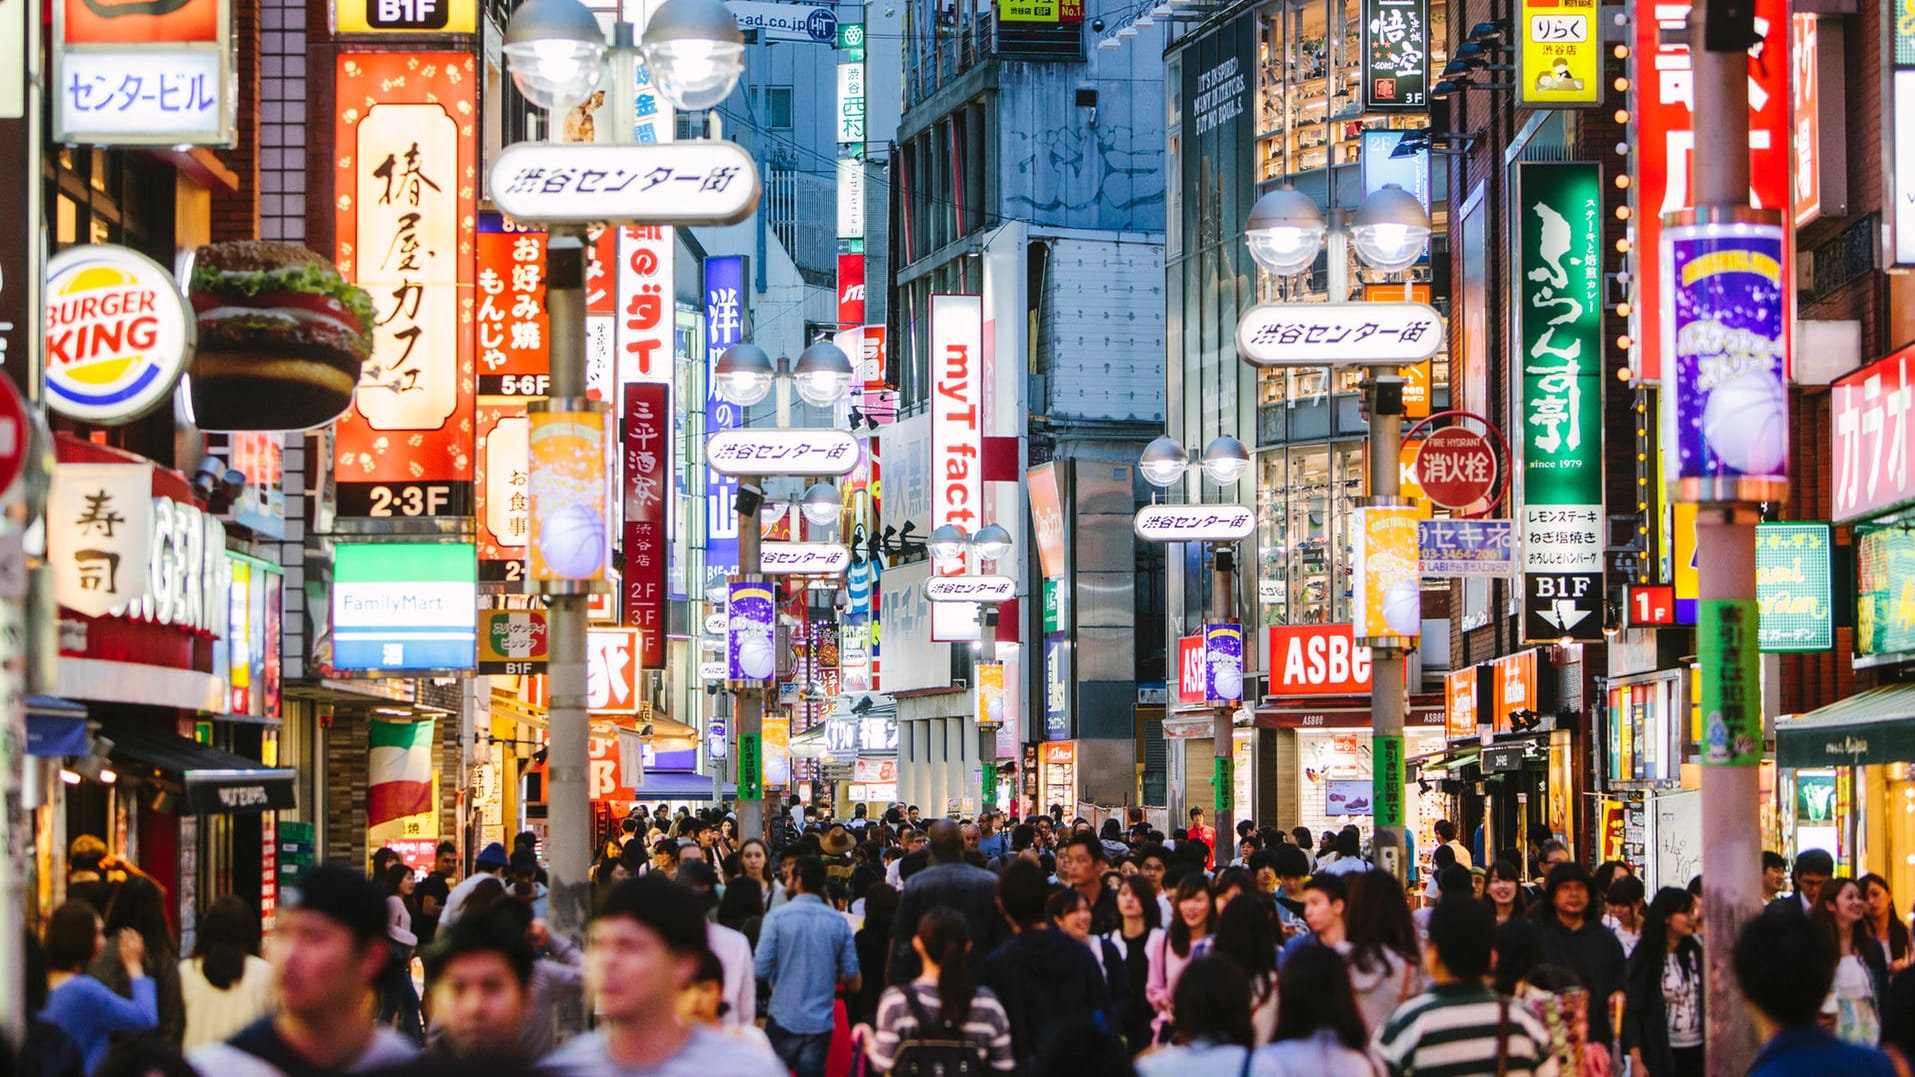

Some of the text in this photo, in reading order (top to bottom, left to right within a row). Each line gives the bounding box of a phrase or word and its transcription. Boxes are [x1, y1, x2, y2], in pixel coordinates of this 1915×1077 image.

[1536, 19, 1580, 39] りらく
[1370, 9, 1423, 77] 悟空
[1542, 45, 1577, 56] 渋谷店
[69, 73, 215, 112] センタービル
[1405, 92, 1423, 103] 3F
[506, 166, 741, 195] 渋谷センター街
[373, 141, 442, 393] 椿屋カフェ
[512, 237, 541, 350] お好み焼
[479, 268, 506, 371] もんじゃ
[45, 316, 159, 369] KING
[1251, 320, 1432, 345] 渋谷センター街
[714, 443, 850, 460] 渋谷センター街
[1428, 438, 1481, 448] FIRE HYDRANT
[1423, 452, 1489, 483] 消火栓
[1530, 459, 1582, 468] since 1979
[1142, 514, 1249, 530] 渋谷センター街
[1529, 510, 1597, 523] レモンステーキ
[74, 489, 124, 594] 寿司
[635, 524, 652, 567] 渋谷店
[760, 551, 843, 566] 谷センター街
[631, 583, 656, 599] 2F
[931, 582, 1009, 595] 渋谷センター街
[1536, 576, 1591, 597] B1F
[343, 594, 443, 614] FamilyMart
[1636, 592, 1666, 621] 1F
[631, 610, 656, 625] 3F
[506, 662, 532, 674] B1F
